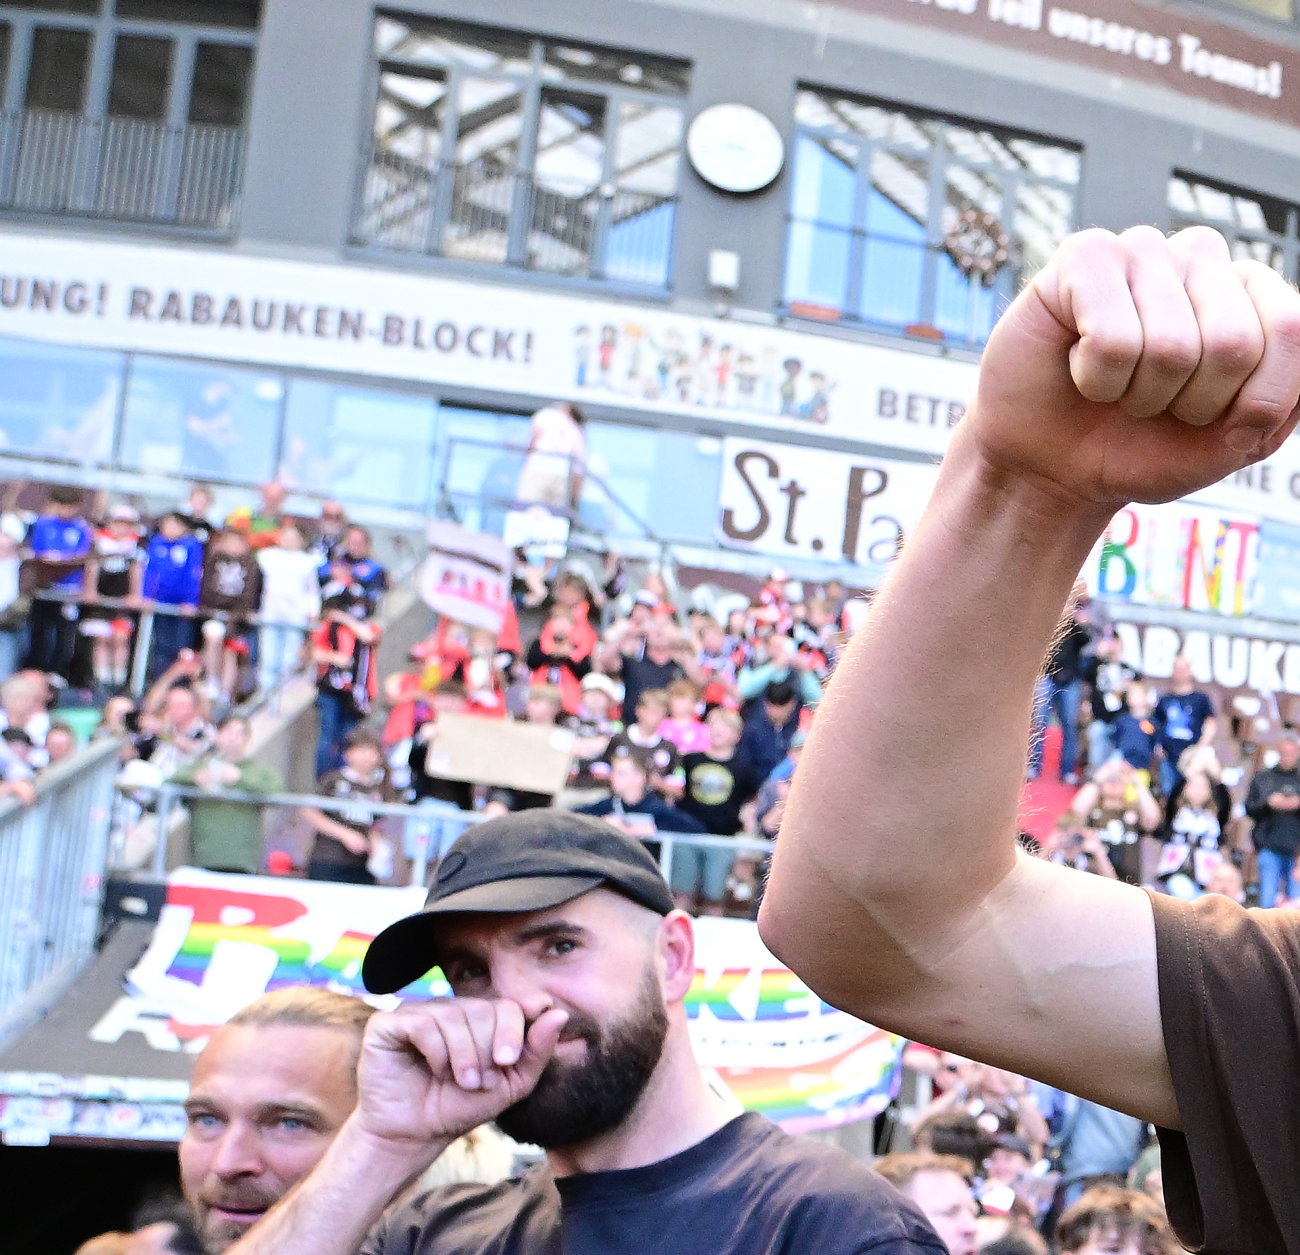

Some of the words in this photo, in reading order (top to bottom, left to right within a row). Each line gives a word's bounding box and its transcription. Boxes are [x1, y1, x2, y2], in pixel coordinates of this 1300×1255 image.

[1048, 8, 1172, 65] unseres
[1178, 34, 1282, 98] Teams!
[127, 286, 536, 364] RABAUKEN-BLOCK!
[722, 450, 823, 552] St.
